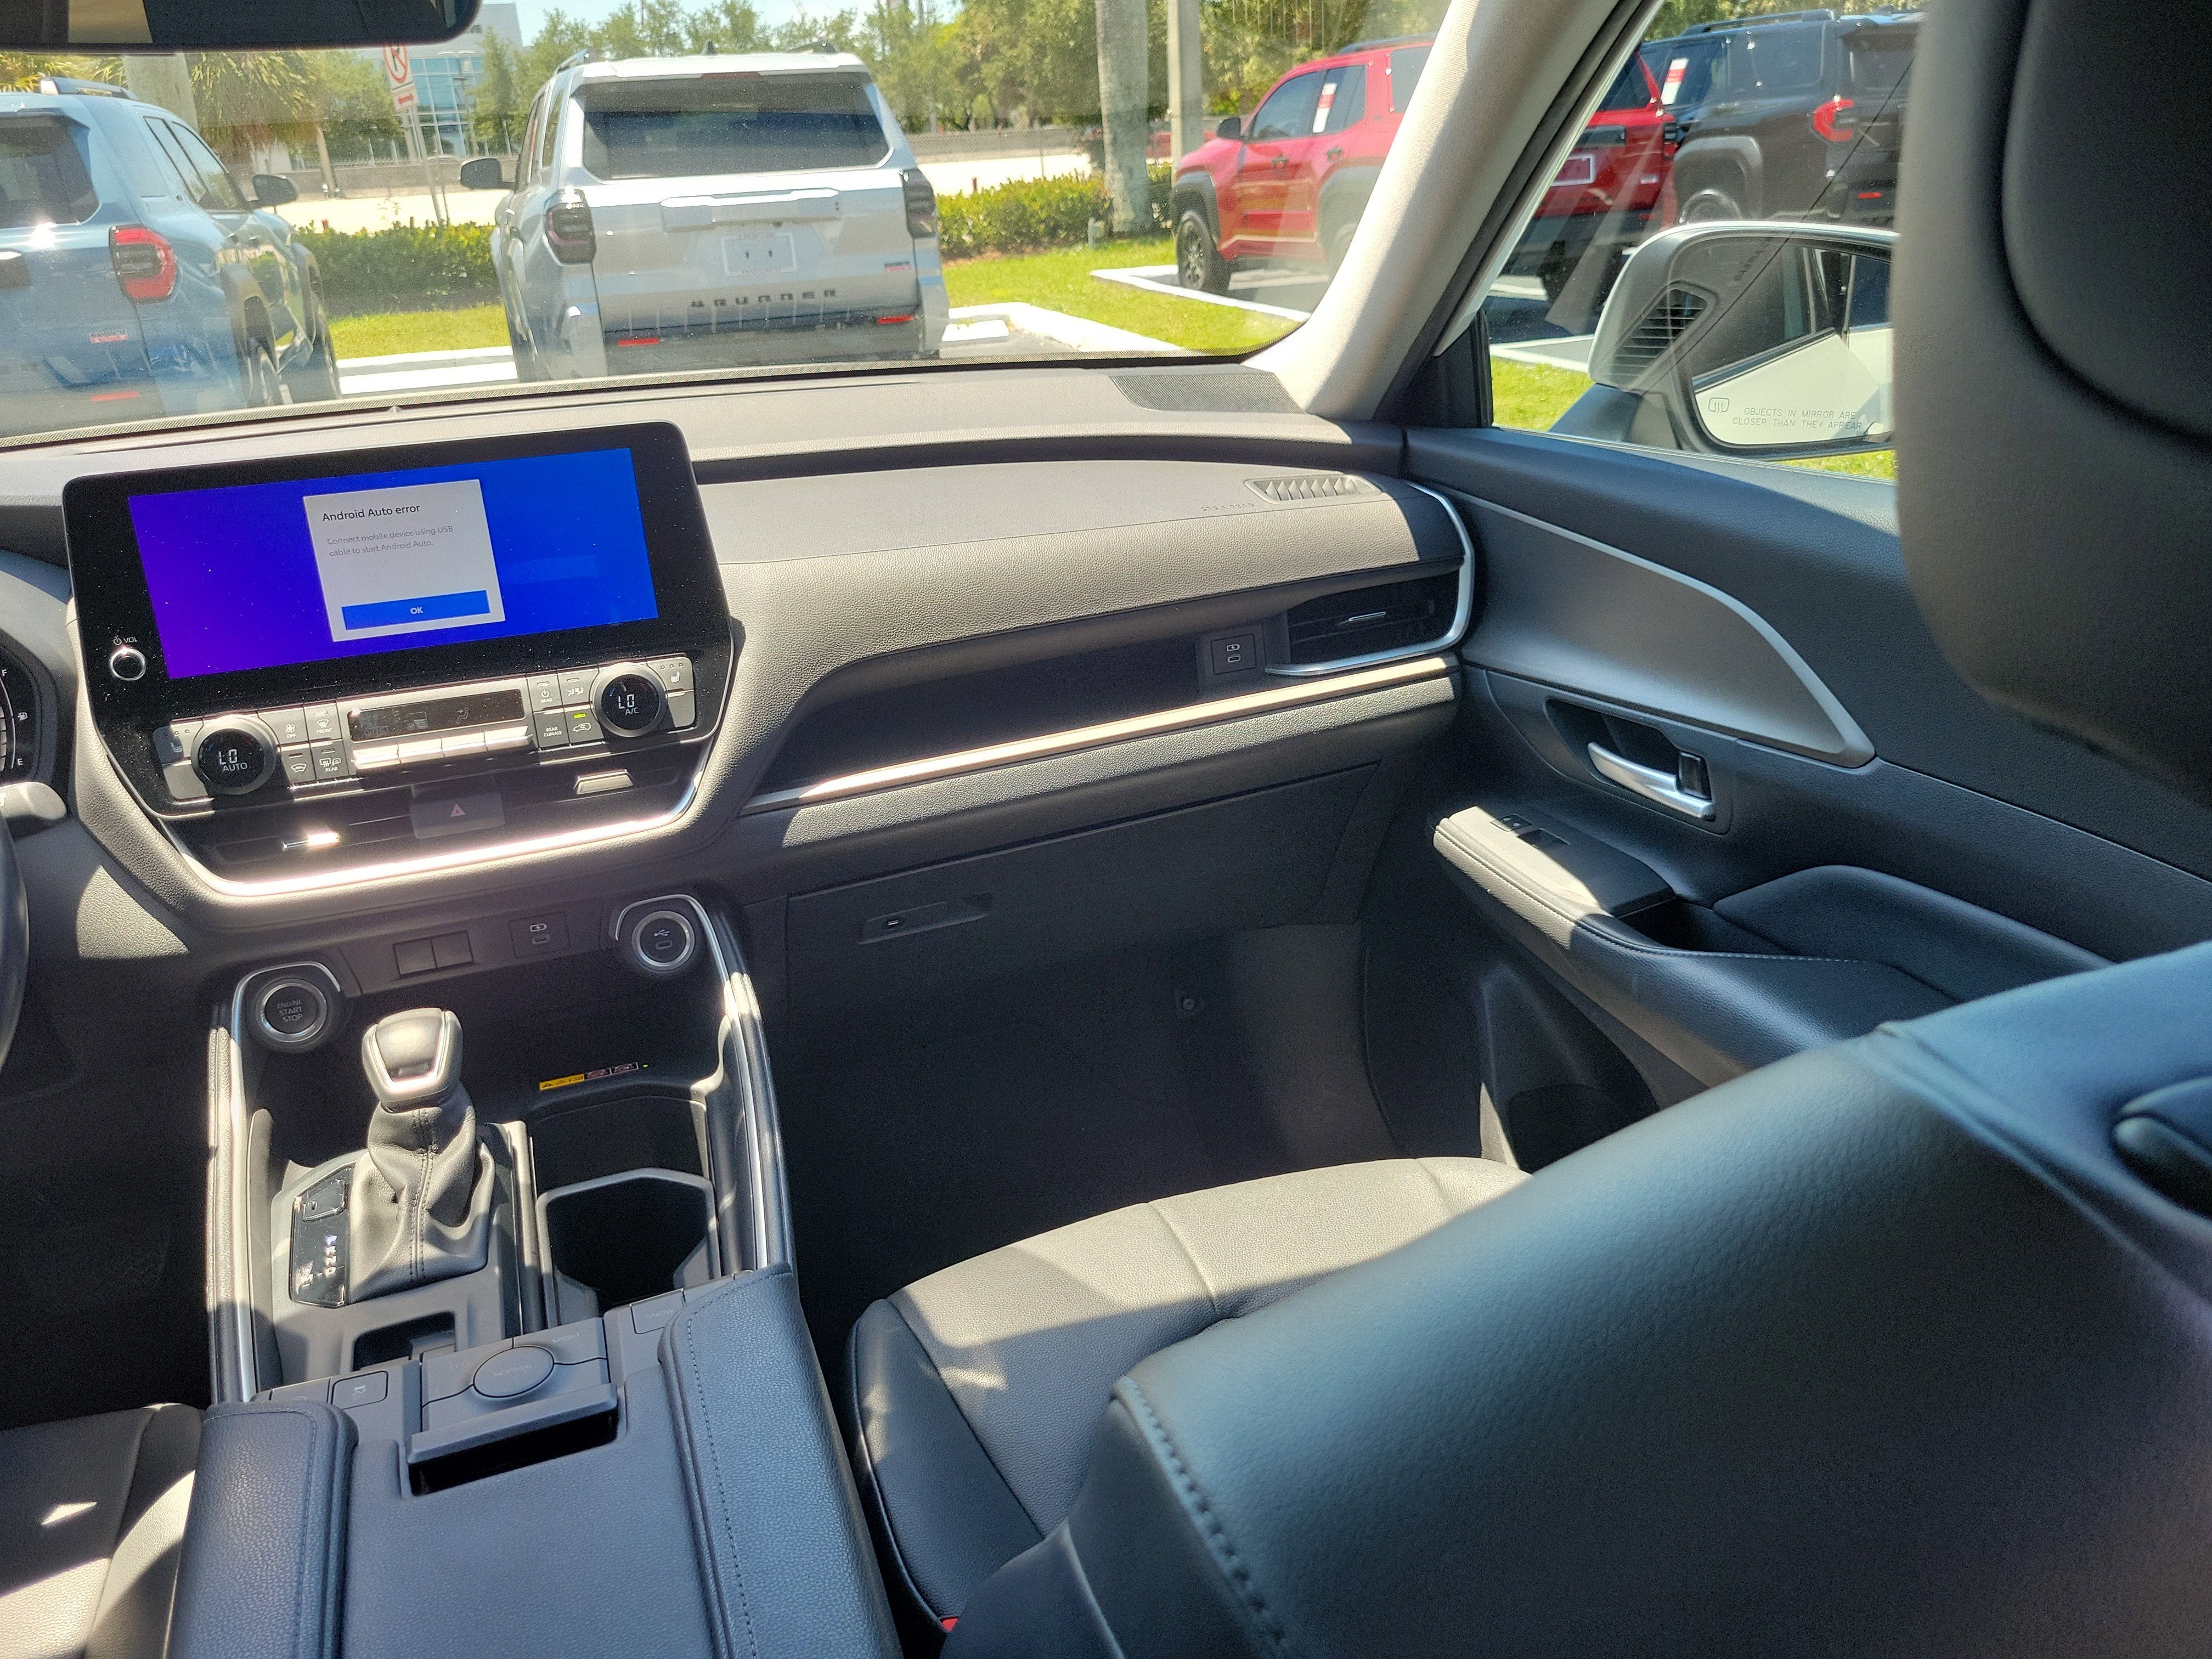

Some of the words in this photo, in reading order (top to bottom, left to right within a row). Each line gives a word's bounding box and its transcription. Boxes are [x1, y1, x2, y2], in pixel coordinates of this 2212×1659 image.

[691, 289, 836, 308] 4RUNNER
[1744, 408, 1782, 416] OBJECTS
[1802, 410, 1835, 418] MIRROR
[1733, 417, 1767, 426] CLOSER
[1827, 421, 1862, 430] APPEAR
[323, 509, 365, 521] Android
[368, 507, 393, 517] Auto
[396, 505, 420, 514] error
[327, 536, 359, 545] Connect
[362, 533, 388, 541] mobile
[390, 530, 414, 539] device
[415, 527, 436, 536] using
[437, 525, 453, 533] USB
[330, 549, 351, 557] cable
[381, 541, 411, 551] Android
[414, 540, 433, 548] Auto.
[410, 606, 424, 615] OK
[625, 707, 639, 715] A/C
[223, 762, 248, 772] AUTO
[279, 1006, 303, 1016] START
[283, 1014, 303, 1023] STOP
[328, 1235, 337, 1245] P
[646, 1308, 675, 1319] SNOW
[551, 1333, 580, 1344] SPORT
[493, 1363, 532, 1378] NORMAL
